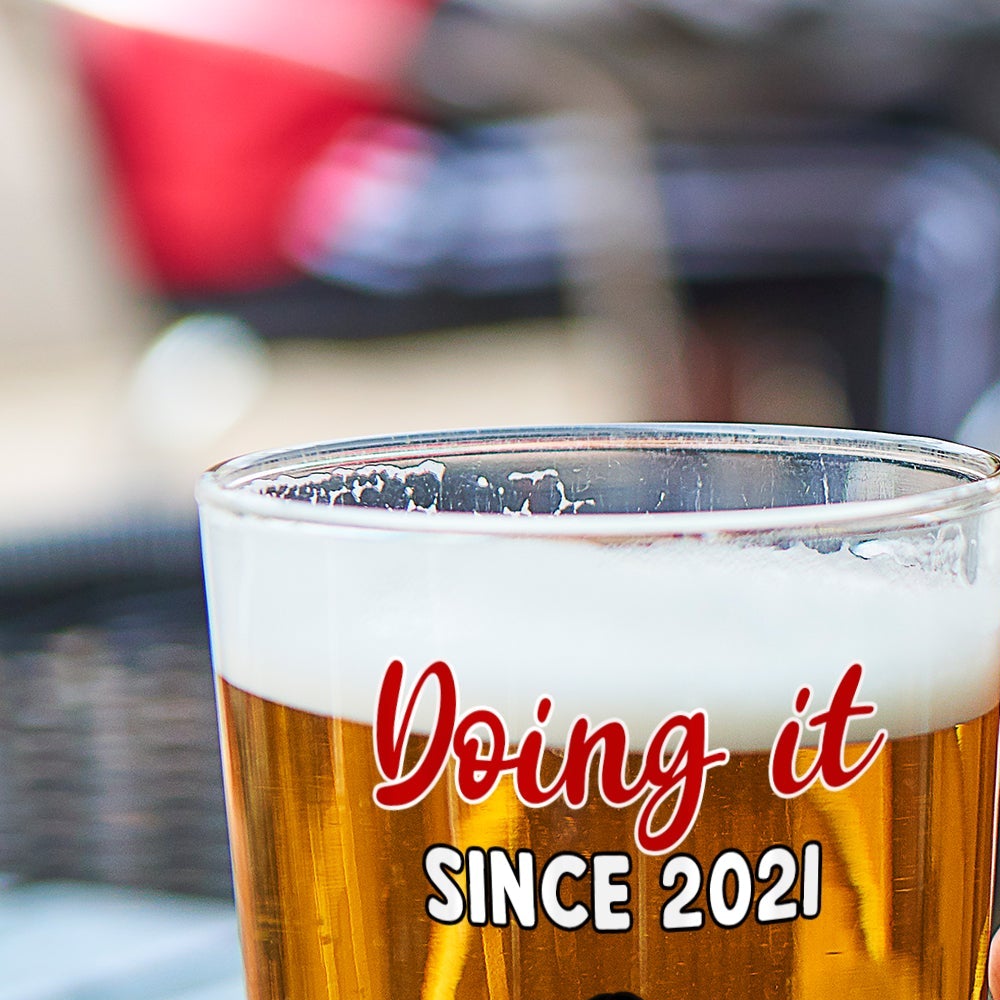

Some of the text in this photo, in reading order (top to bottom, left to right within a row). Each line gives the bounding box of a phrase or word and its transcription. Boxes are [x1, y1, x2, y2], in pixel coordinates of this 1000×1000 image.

[373, 657, 888, 855] Doing it
[422, 840, 822, 933] SINCE 2021
